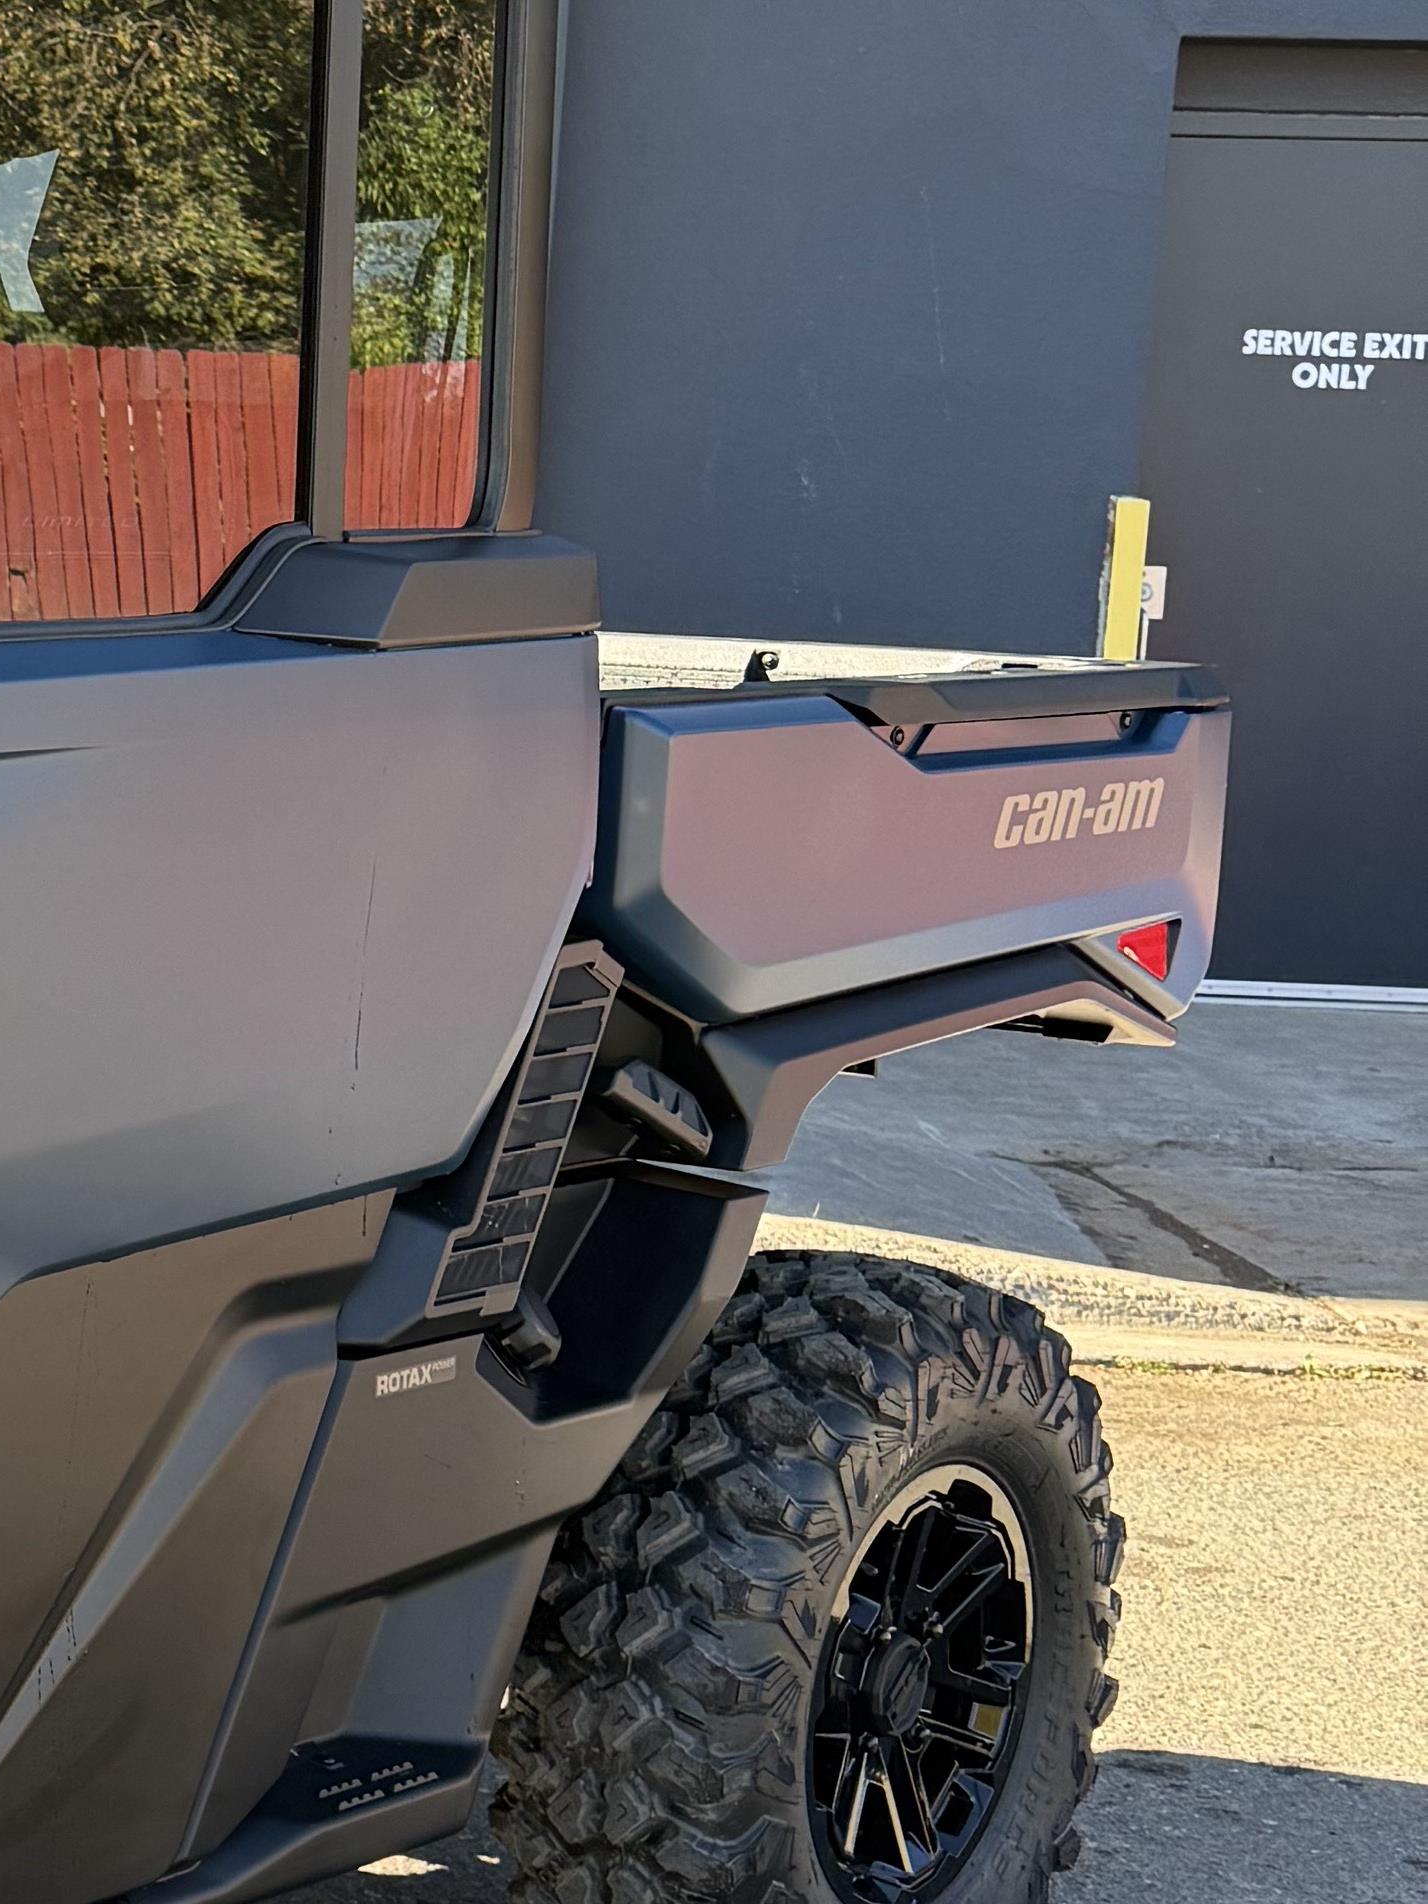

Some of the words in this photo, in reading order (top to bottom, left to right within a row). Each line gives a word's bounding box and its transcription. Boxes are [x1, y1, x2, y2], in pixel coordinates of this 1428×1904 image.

[1242, 329, 1358, 358] SERVICE
[1363, 332, 1428, 360] EXIT
[1291, 362, 1375, 390] ONLY
[994, 777, 1165, 849] can-am
[376, 1363, 432, 1398] ROTAX
